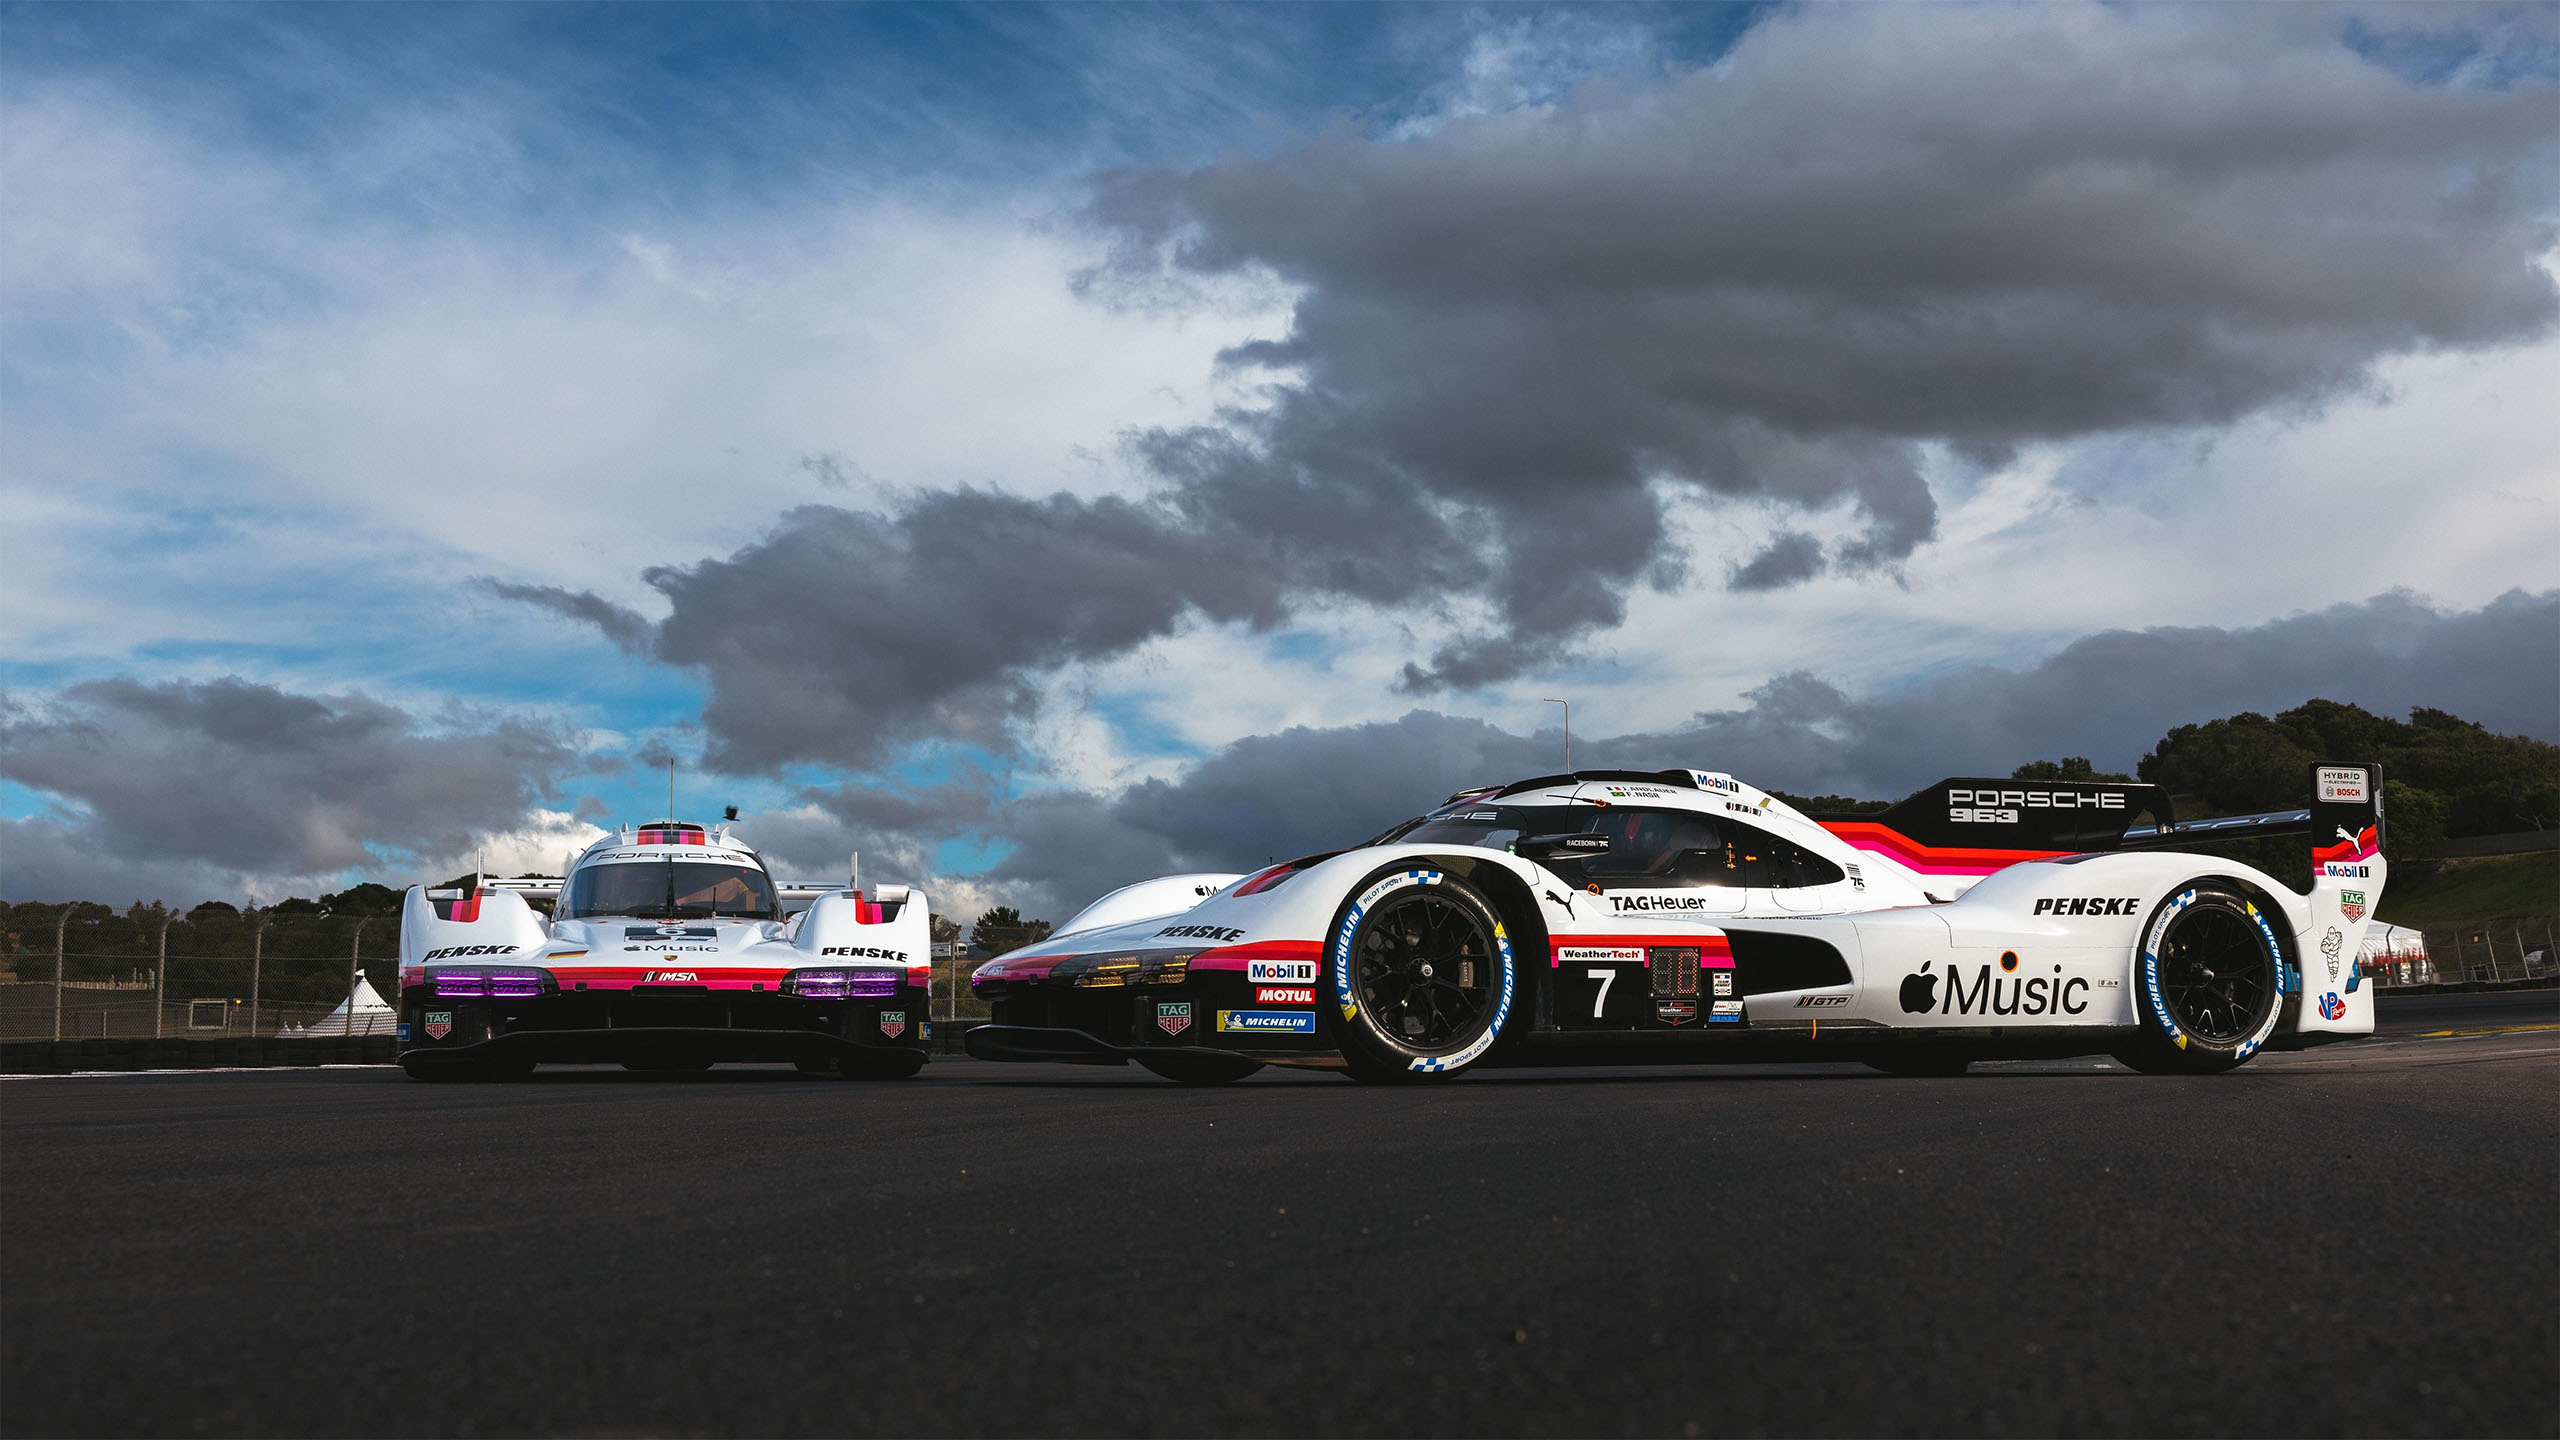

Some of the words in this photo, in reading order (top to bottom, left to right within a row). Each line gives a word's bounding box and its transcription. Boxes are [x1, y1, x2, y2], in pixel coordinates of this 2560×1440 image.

[1697, 774, 1728, 790] Mobil
[1729, 781, 1739, 793] 1
[2324, 772, 2360, 780] HYBRID
[1949, 789, 2125, 808] PORSCHE
[2336, 788, 2360, 796] BOSCH
[1949, 808, 2018, 823] 963
[597, 852, 746, 862] PORSCHE
[2327, 865, 2357, 878] Mobil
[2358, 866, 2369, 878] 1
[1363, 887, 1380, 905] PILOT
[1381, 877, 1404, 891] SPORT
[2343, 893, 2363, 904] TAG
[2033, 898, 2140, 916] PENSKE
[2342, 904, 2365, 919] HEUER
[1154, 925, 1246, 942] PENSKE
[2150, 931, 2160, 950] PILOT
[2157, 910, 2171, 931] SPORT
[421, 945, 520, 963] PENSKE
[821, 947, 908, 963] PENSKE
[1336, 910, 1360, 989] MICHELIN
[1564, 950, 1638, 959] WeatherTech
[2261, 924, 2284, 991] MICHELIN
[658, 972, 699, 981] IMSA
[1252, 964, 1294, 978] Mobil
[1297, 965, 1311, 979] 1
[1258, 989, 1313, 1002] MOTUL
[1493, 953, 1513, 1031] MICHELIN
[1587, 969, 1616, 1018] 7
[1941, 964, 2090, 1015] Music
[2146, 959, 2173, 1028] MICHELIN
[1813, 997, 1848, 1006] GTP
[2318, 992, 2338, 1020] VP
[883, 1013, 903, 1022] TAG
[1160, 1005, 1188, 1015] TAG
[427, 1014, 449, 1023] TAG
[1160, 1017, 1189, 1033] HEUER
[1245, 1017, 1307, 1027] MICHELIN
[427, 1023, 451, 1037] HEUER
[881, 1022, 905, 1037] HEUER
[1474, 1036, 1490, 1055] PILOT
[1450, 1052, 1473, 1066] SPORT
